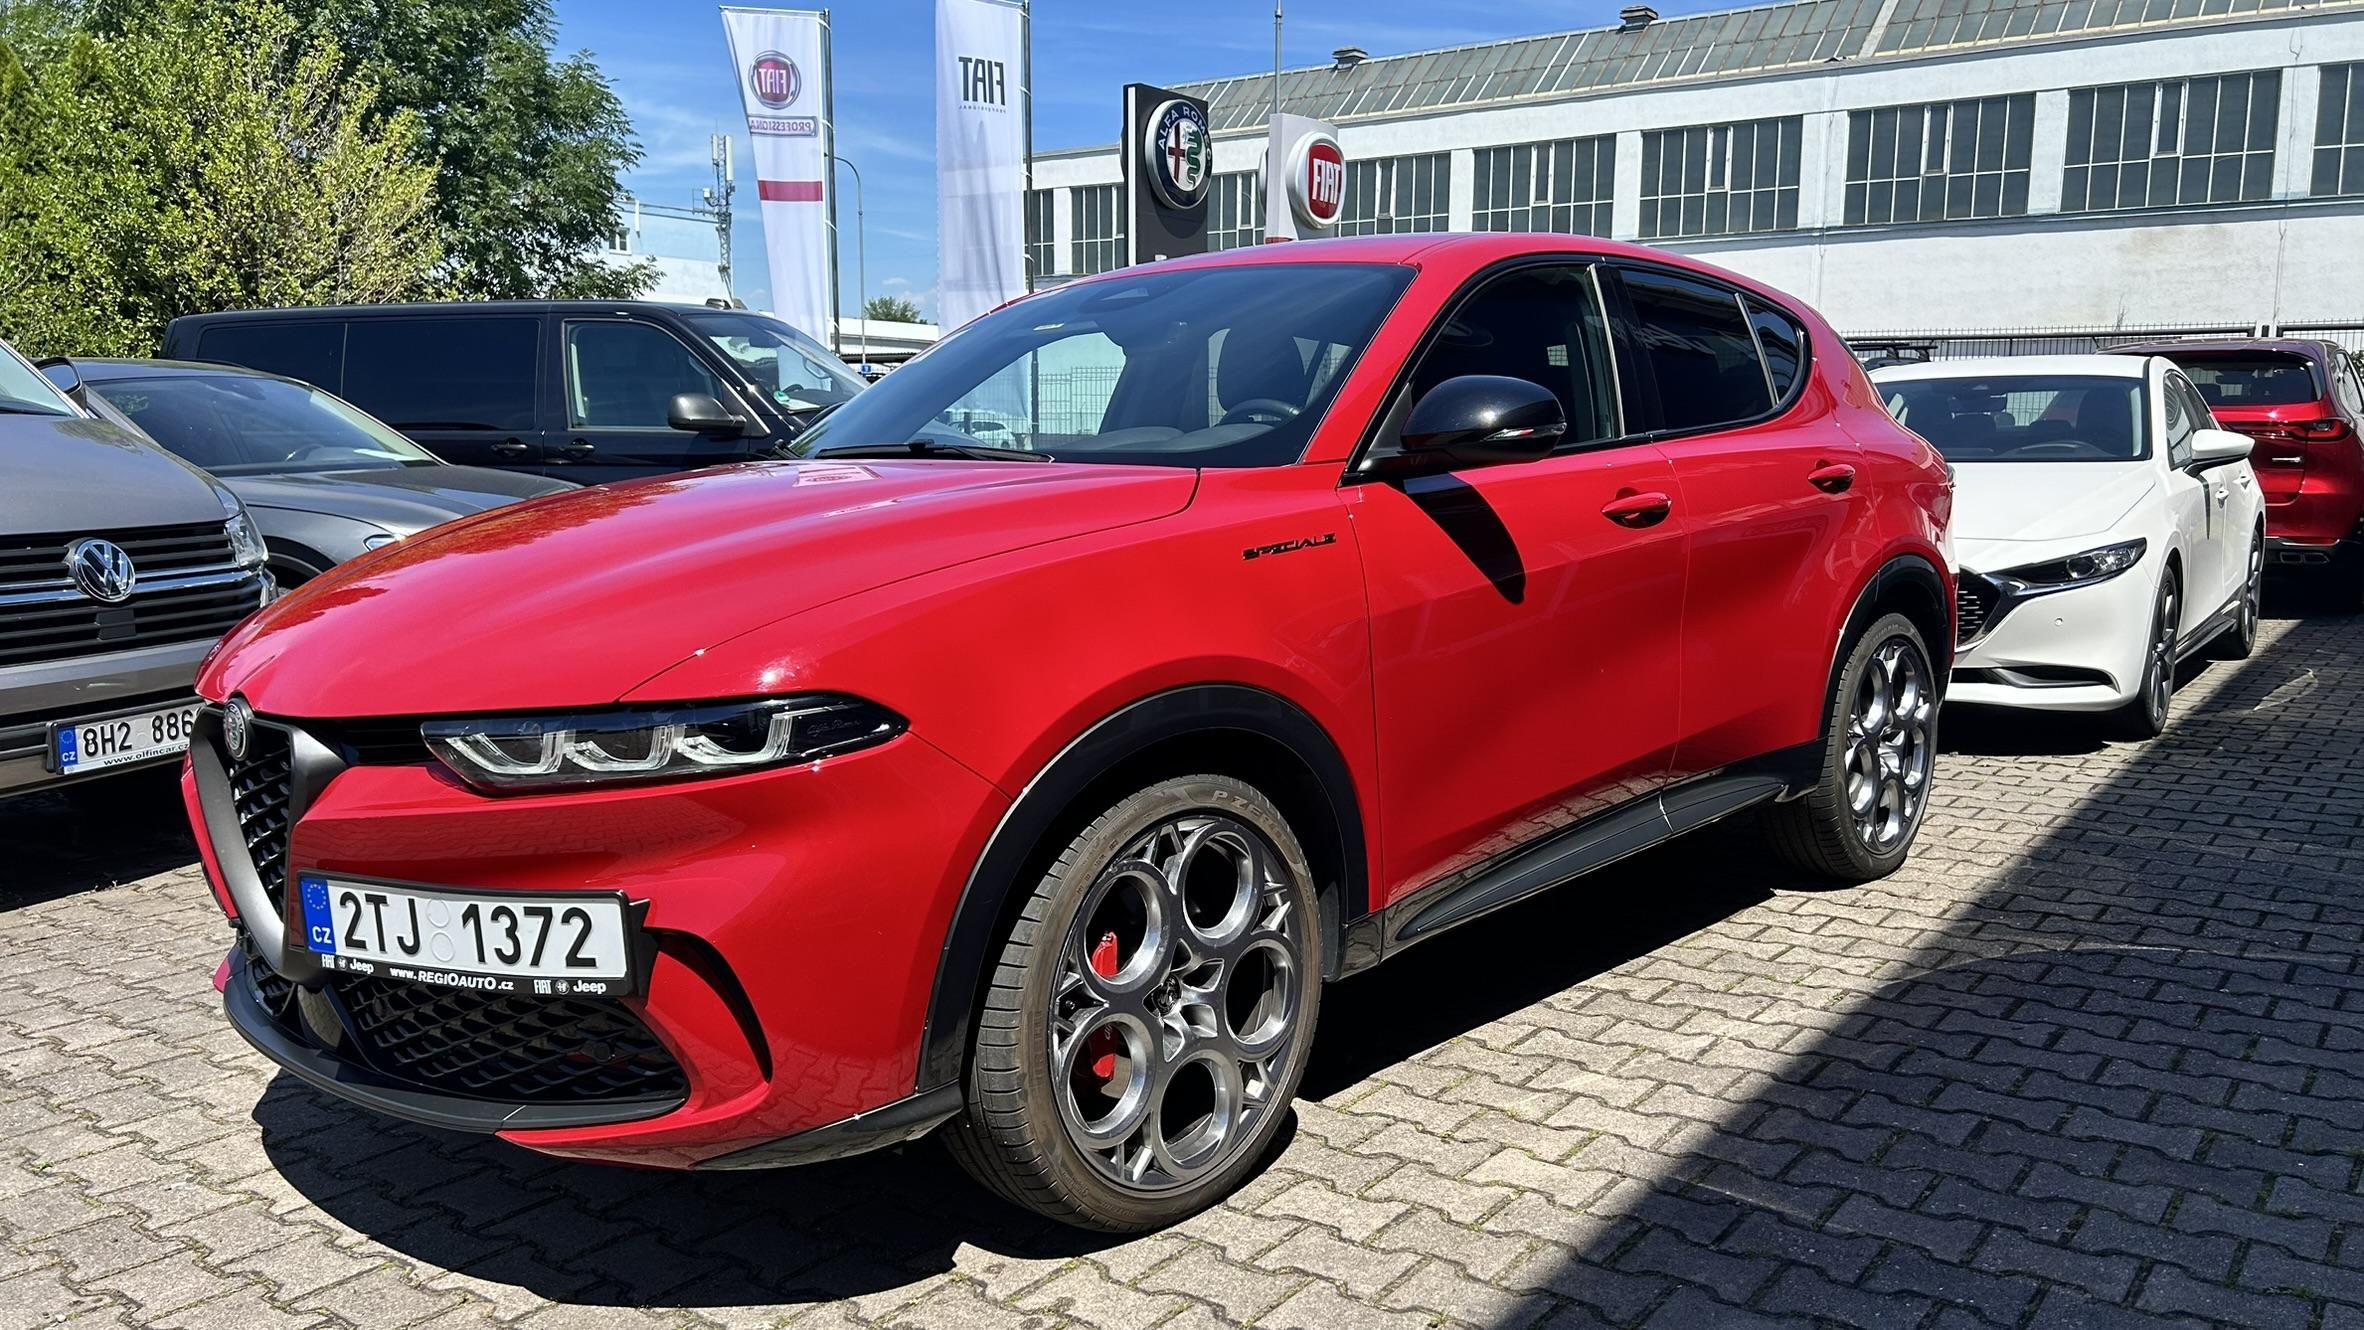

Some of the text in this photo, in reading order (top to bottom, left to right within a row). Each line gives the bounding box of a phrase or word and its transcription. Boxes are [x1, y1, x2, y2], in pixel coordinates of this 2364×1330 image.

[1158, 106, 1212, 158] ALFA ROMEO
[1311, 158, 1341, 205] FIAT
[83, 721, 132, 757] 8H2
[152, 710, 194, 743] 886
[62, 751, 76, 762] CZ
[103, 743, 189, 766] www.olfincar.cz
[312, 926, 332, 944] CZ
[339, 891, 597, 968] 2TJ 1372
[350, 958, 374, 974] Jeep
[533, 979, 606, 994] FIAT Jeep
